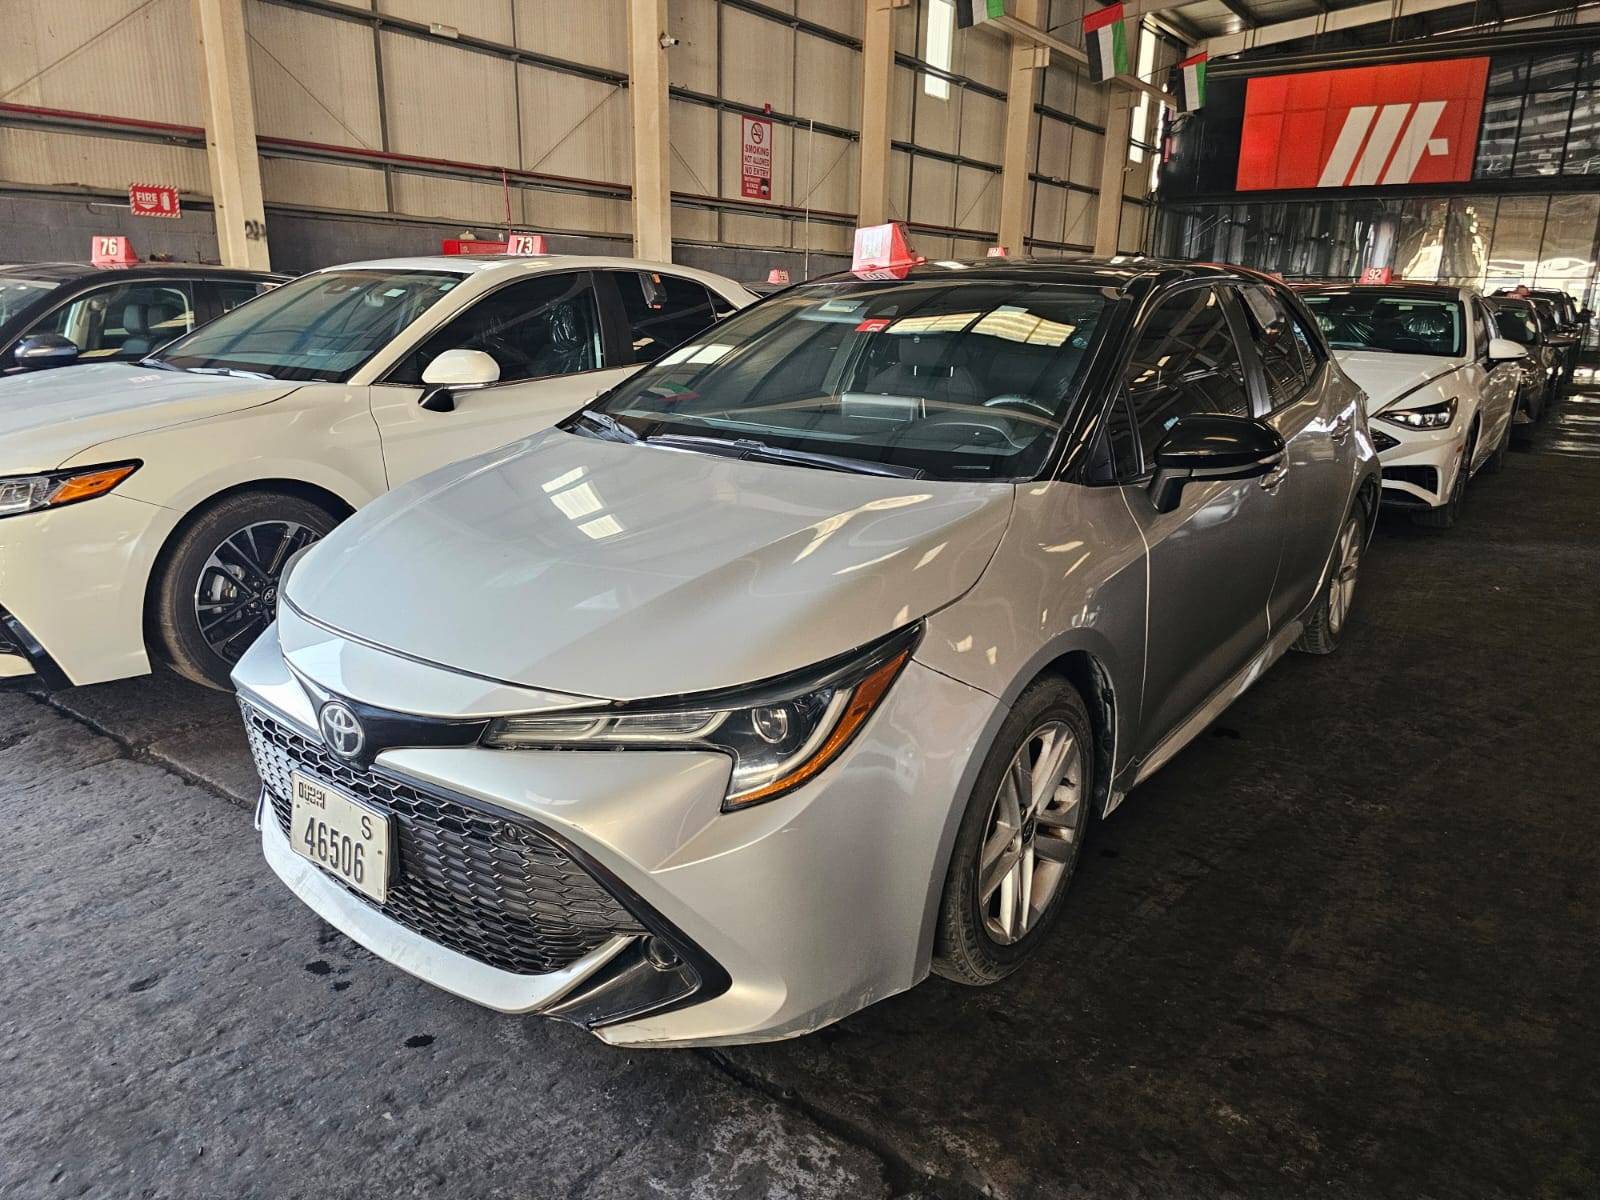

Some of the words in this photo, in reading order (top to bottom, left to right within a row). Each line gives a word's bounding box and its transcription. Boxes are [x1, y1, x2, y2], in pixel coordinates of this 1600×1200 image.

[745, 143, 770, 157] SMOKING
[744, 165, 753, 175] NO
[753, 167, 769, 177] ENTRY
[136, 191, 158, 203] FIRE
[100, 238, 118, 256] 76
[517, 237, 533, 254] 73
[1368, 268, 1382, 280] 92
[361, 815, 373, 841] S
[304, 816, 366, 885] 46506
